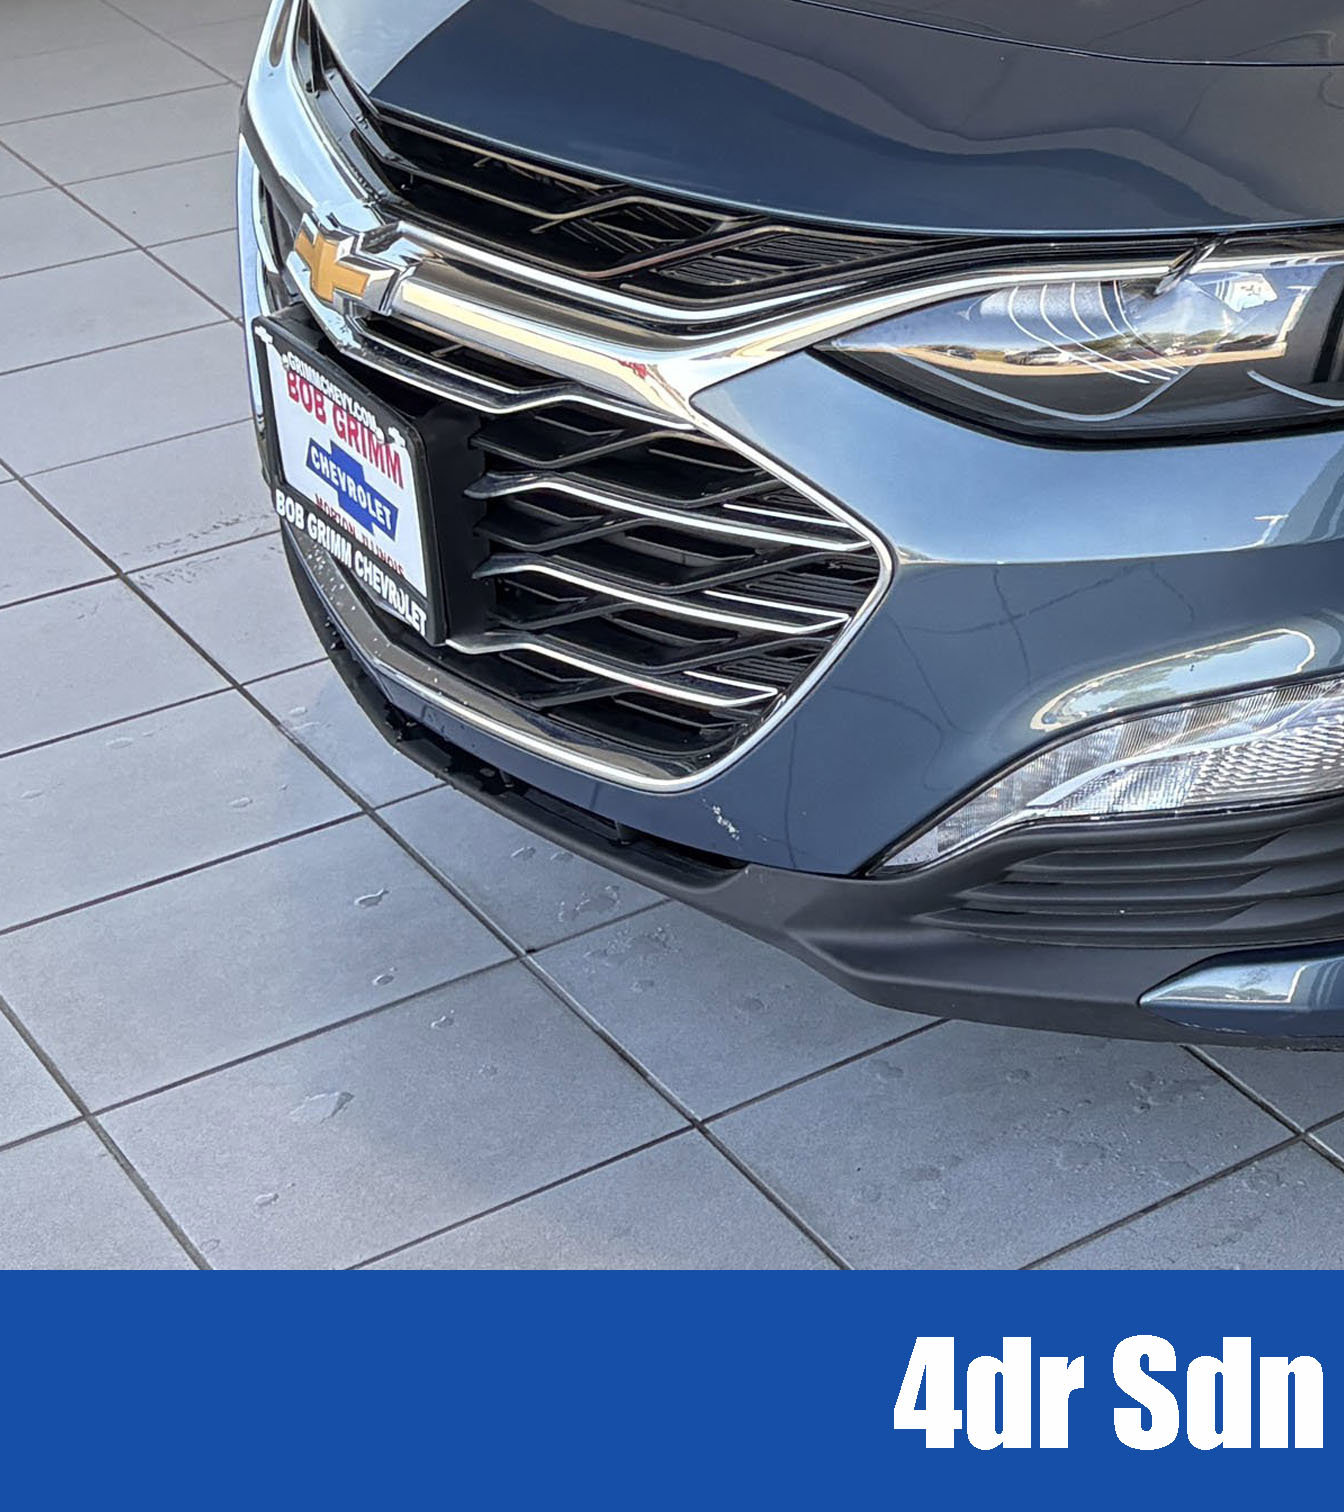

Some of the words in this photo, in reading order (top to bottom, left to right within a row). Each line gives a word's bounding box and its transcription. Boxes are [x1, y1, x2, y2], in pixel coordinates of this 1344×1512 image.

[286, 368, 327, 425] BOB
[332, 402, 404, 490] GRIMM
[310, 445, 393, 531] CHEVROLET
[275, 488, 305, 530] BOB
[307, 512, 353, 569] GRIMM
[354, 550, 428, 637] CHEVROLET
